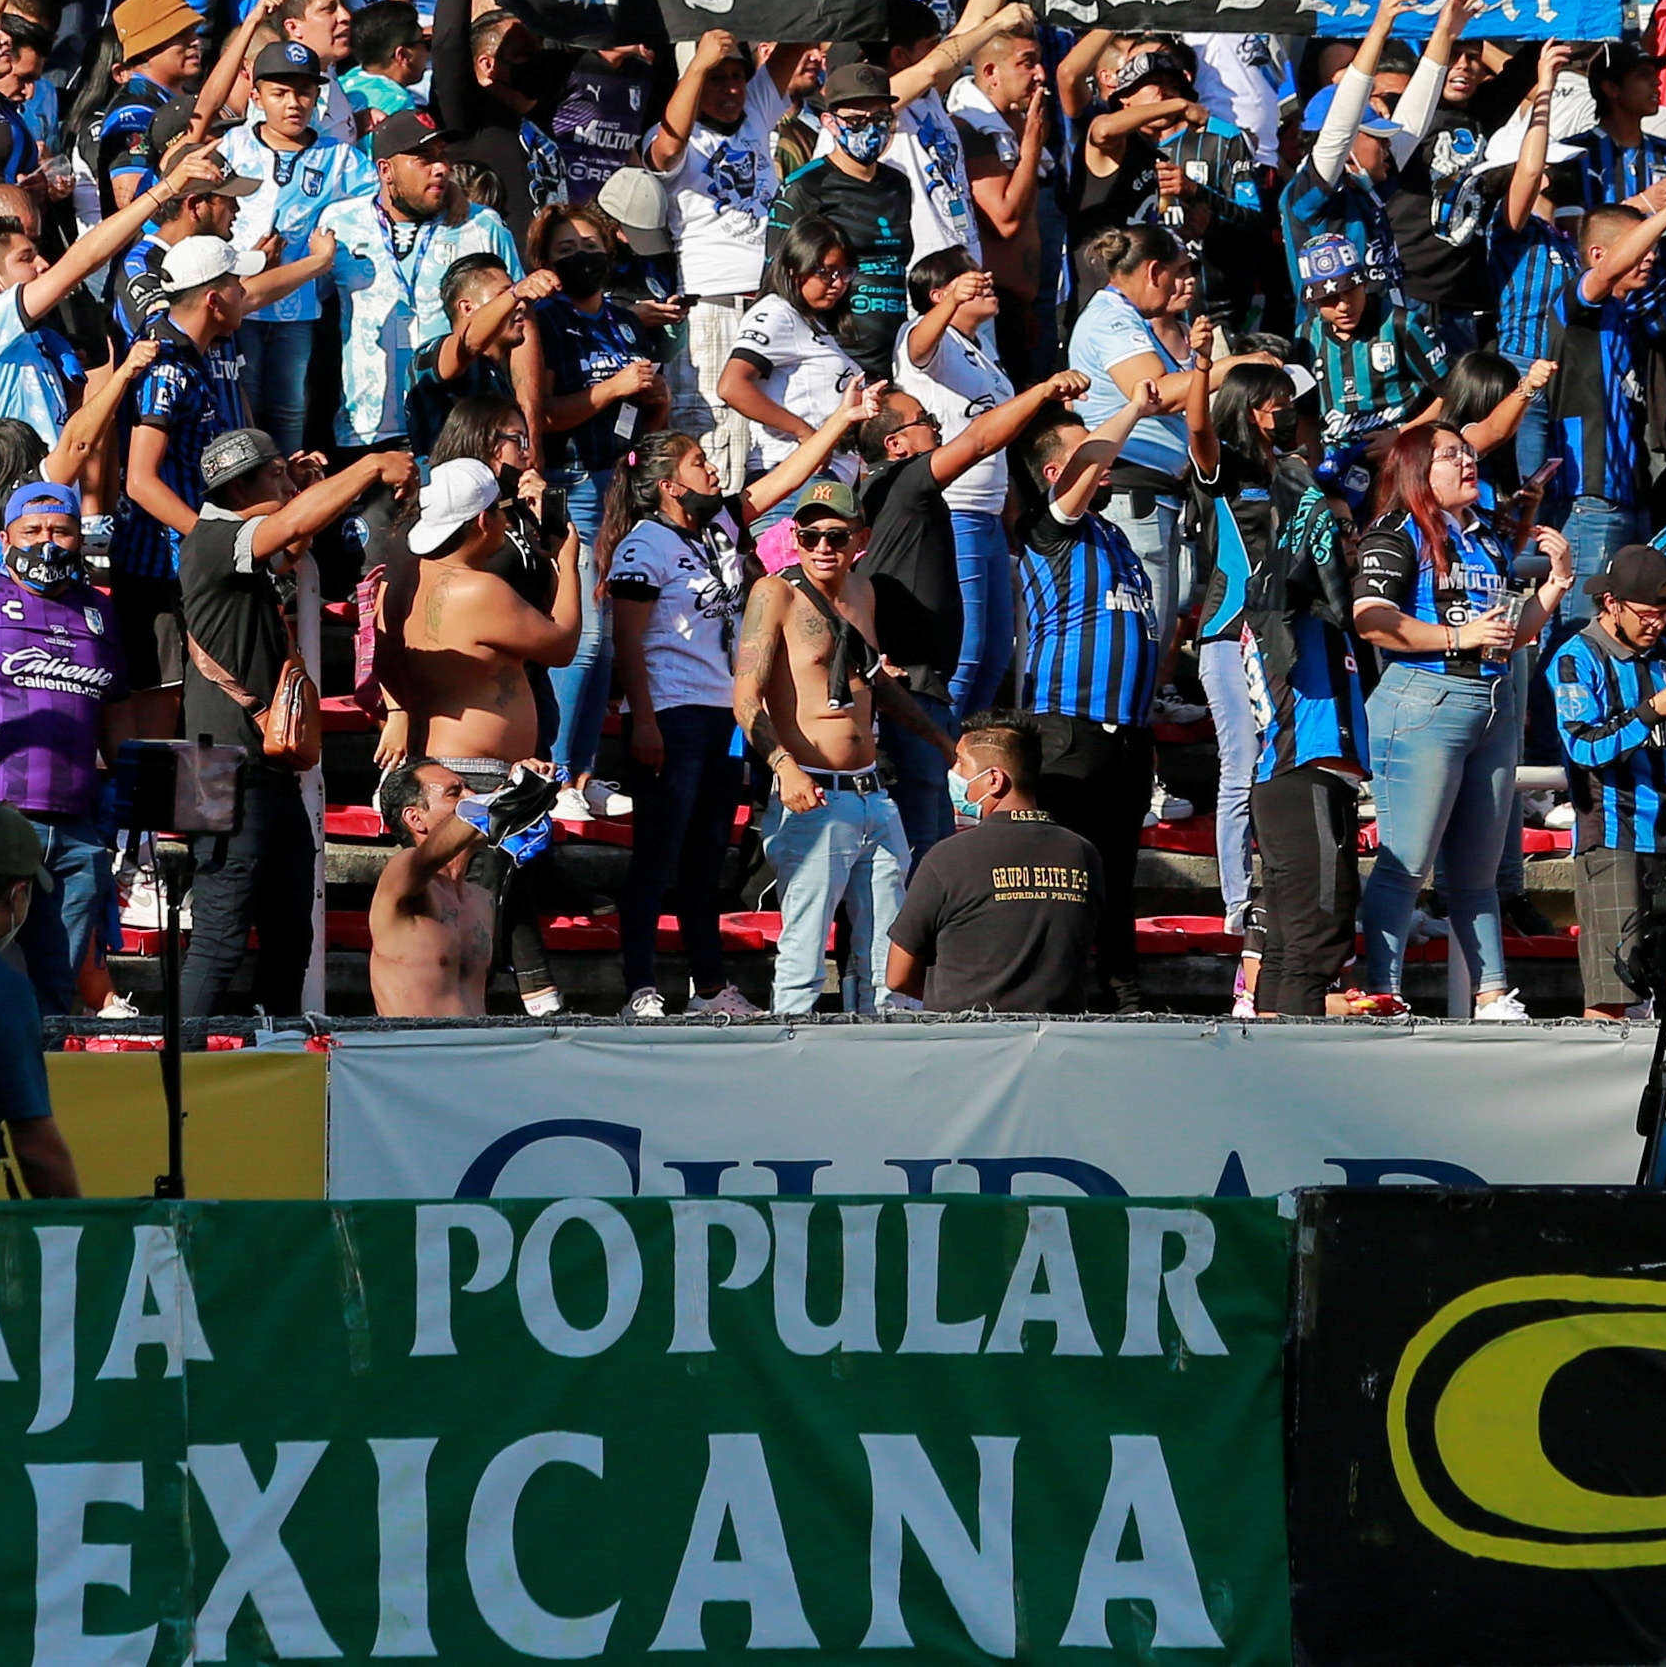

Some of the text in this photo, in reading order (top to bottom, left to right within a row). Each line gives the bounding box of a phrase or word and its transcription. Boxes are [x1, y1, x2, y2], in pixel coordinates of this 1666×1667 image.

[0, 646, 79, 687] Caliente
[11, 674, 71, 700] caliente.mx
[992, 866, 1030, 890] GRUPO
[1032, 865, 1068, 888] ELITE
[994, 891, 1087, 904] SEGURIDAD PRIVADA
[409, 1197, 1229, 1357] POPULAR
